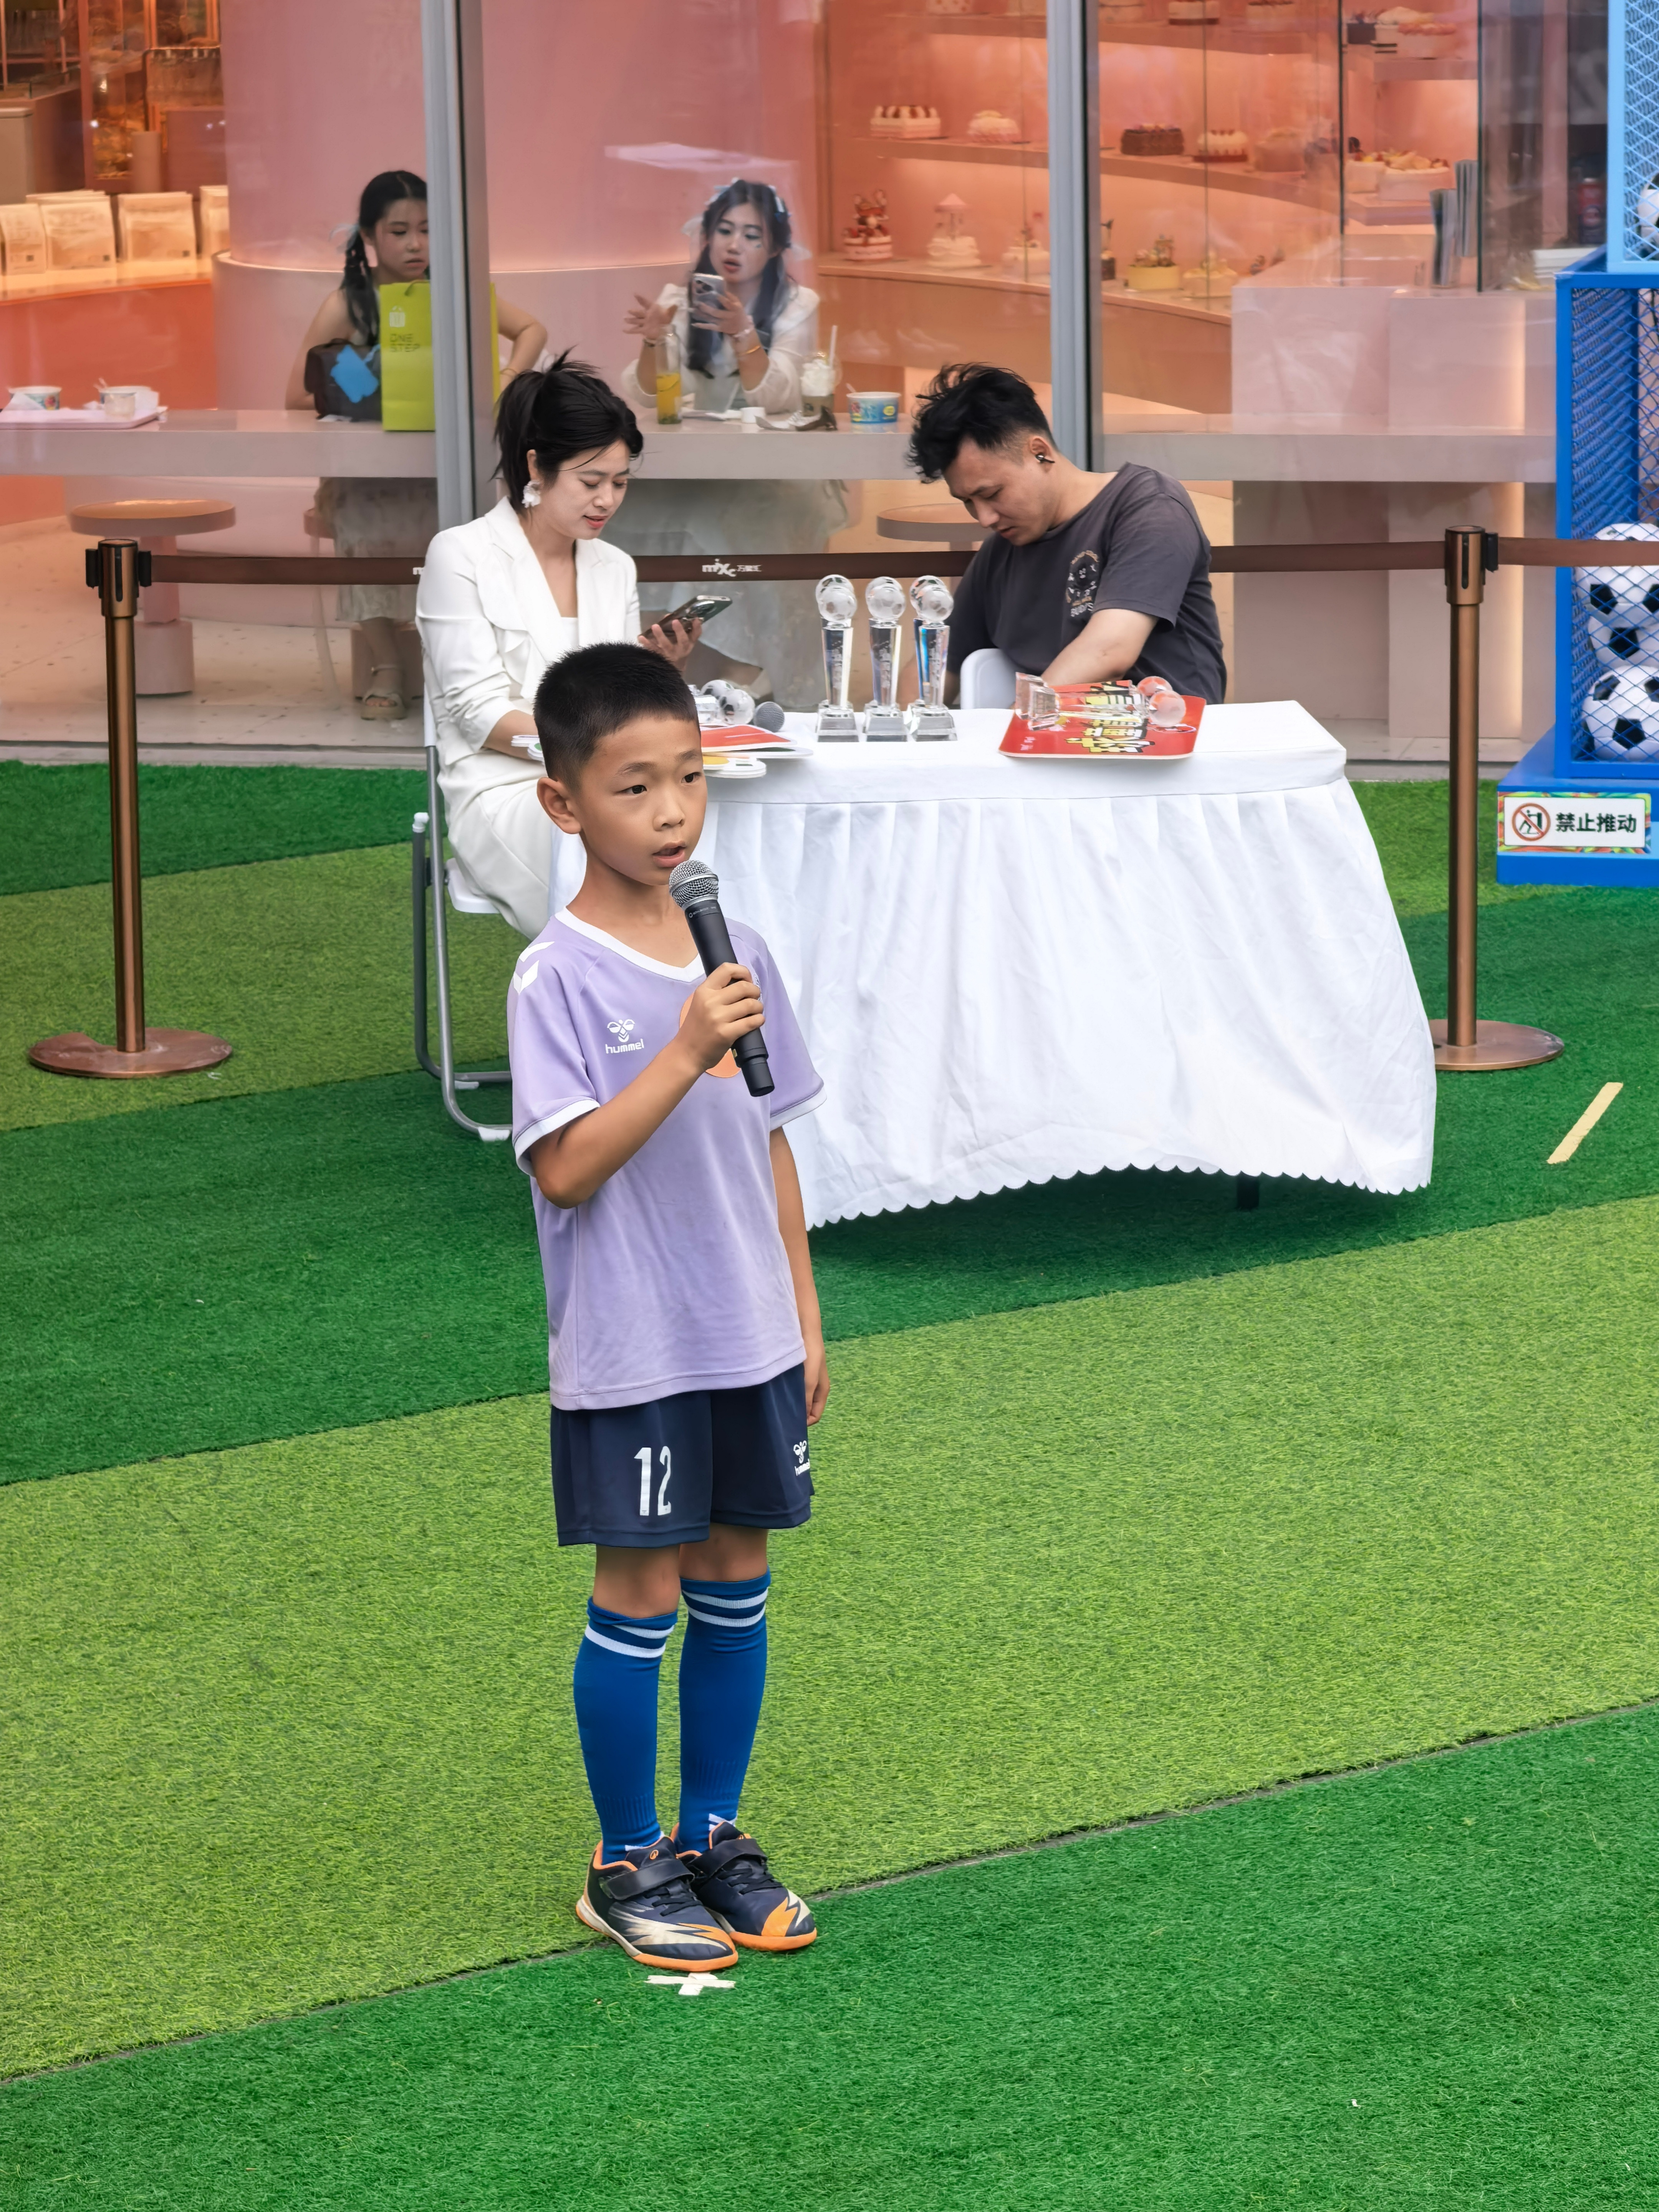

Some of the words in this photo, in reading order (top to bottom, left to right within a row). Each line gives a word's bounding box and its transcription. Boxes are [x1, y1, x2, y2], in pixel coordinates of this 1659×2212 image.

[390, 333, 414, 343] ONE
[1555, 812, 1637, 833] 禁止推动
[605, 1038, 644, 1054] hummel
[634, 1446, 671, 1516] 12
